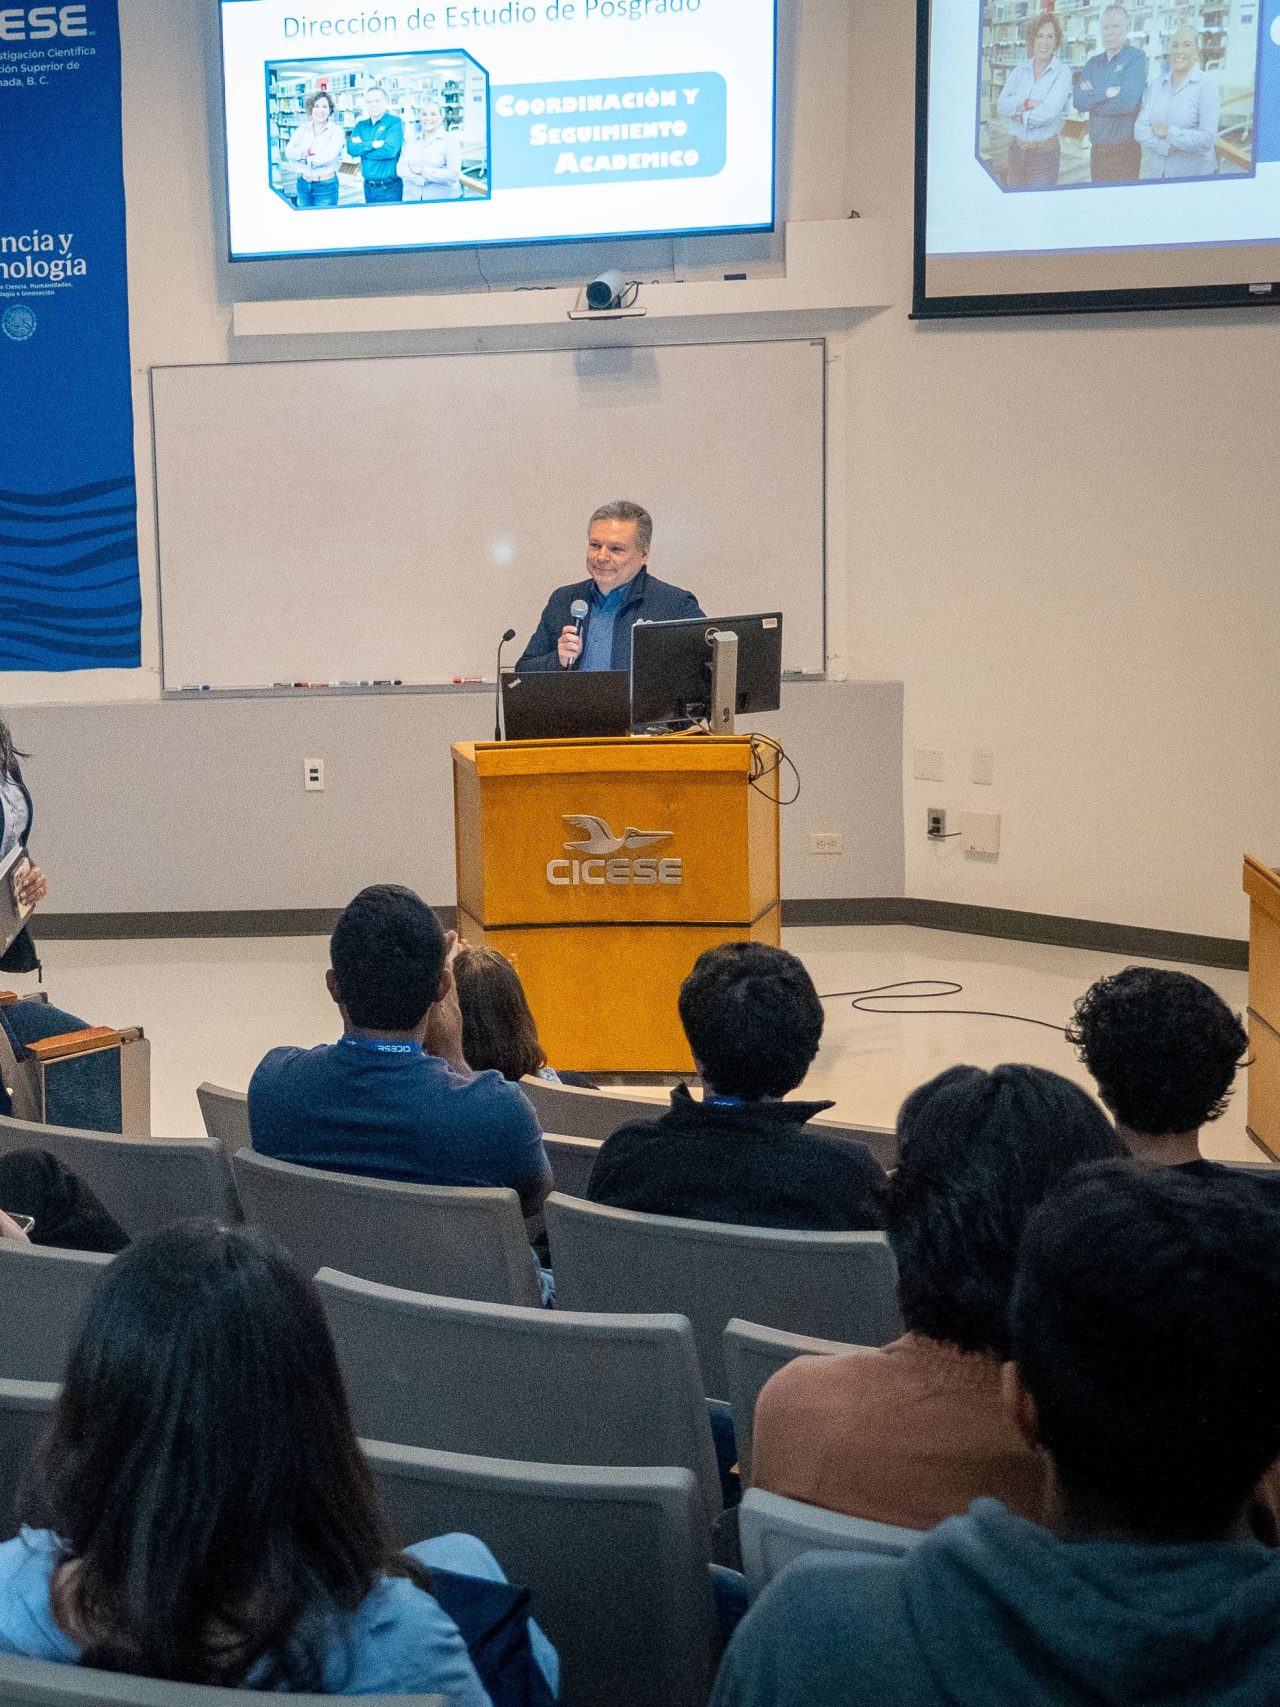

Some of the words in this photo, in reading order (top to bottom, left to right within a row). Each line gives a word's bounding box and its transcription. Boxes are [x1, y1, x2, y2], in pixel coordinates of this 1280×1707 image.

[283, 10, 398, 39] Dirección
[407, 7, 436, 31] de
[446, 2, 536, 28] Estudio
[546, 0, 575, 21] de
[47, 46, 96, 58] Científica
[20, 62, 64, 73] Superior
[66, 61, 81, 70] de
[26, 77, 37, 86] B.
[39, 76, 49, 85] C.
[682, 88, 701, 105] Y
[58, 233, 74, 255] y
[545, 858, 683, 886] CICESE
